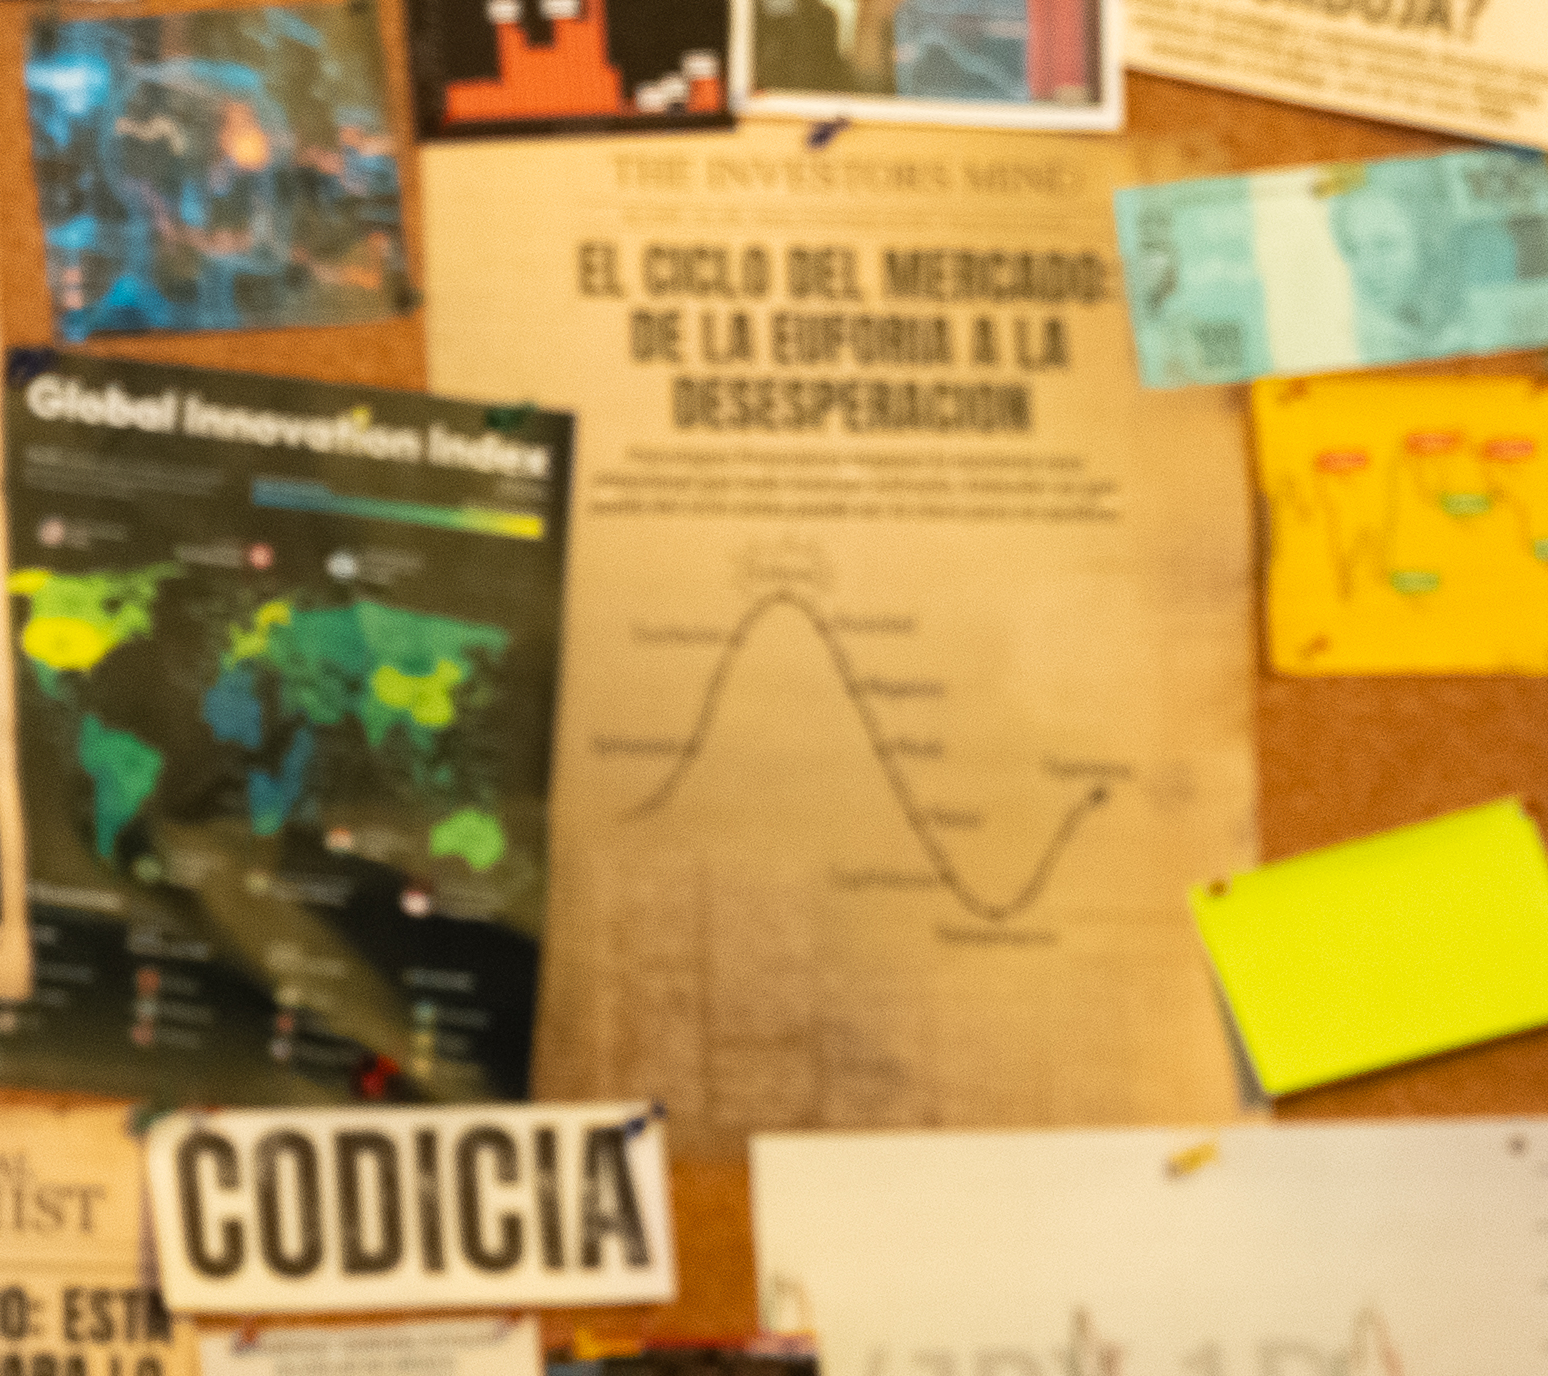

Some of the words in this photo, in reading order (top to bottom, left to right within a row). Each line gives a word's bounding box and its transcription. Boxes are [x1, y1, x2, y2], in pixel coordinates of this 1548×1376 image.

[578, 241, 626, 298] EL
[642, 243, 769, 299] CICLO
[788, 246, 865, 302] DEL
[631, 309, 684, 363] DE
[701, 310, 756, 364] LA
[769, 312, 954, 367] EUFORIA
[1011, 316, 1070, 371] LA
[26, 373, 176, 432] Global
[183, 400, 423, 462] Innovation
[429, 424, 550, 478] Index
[671, 375, 1033, 433] DESESPERACION
[174, 1120, 652, 1280] CODICIA
